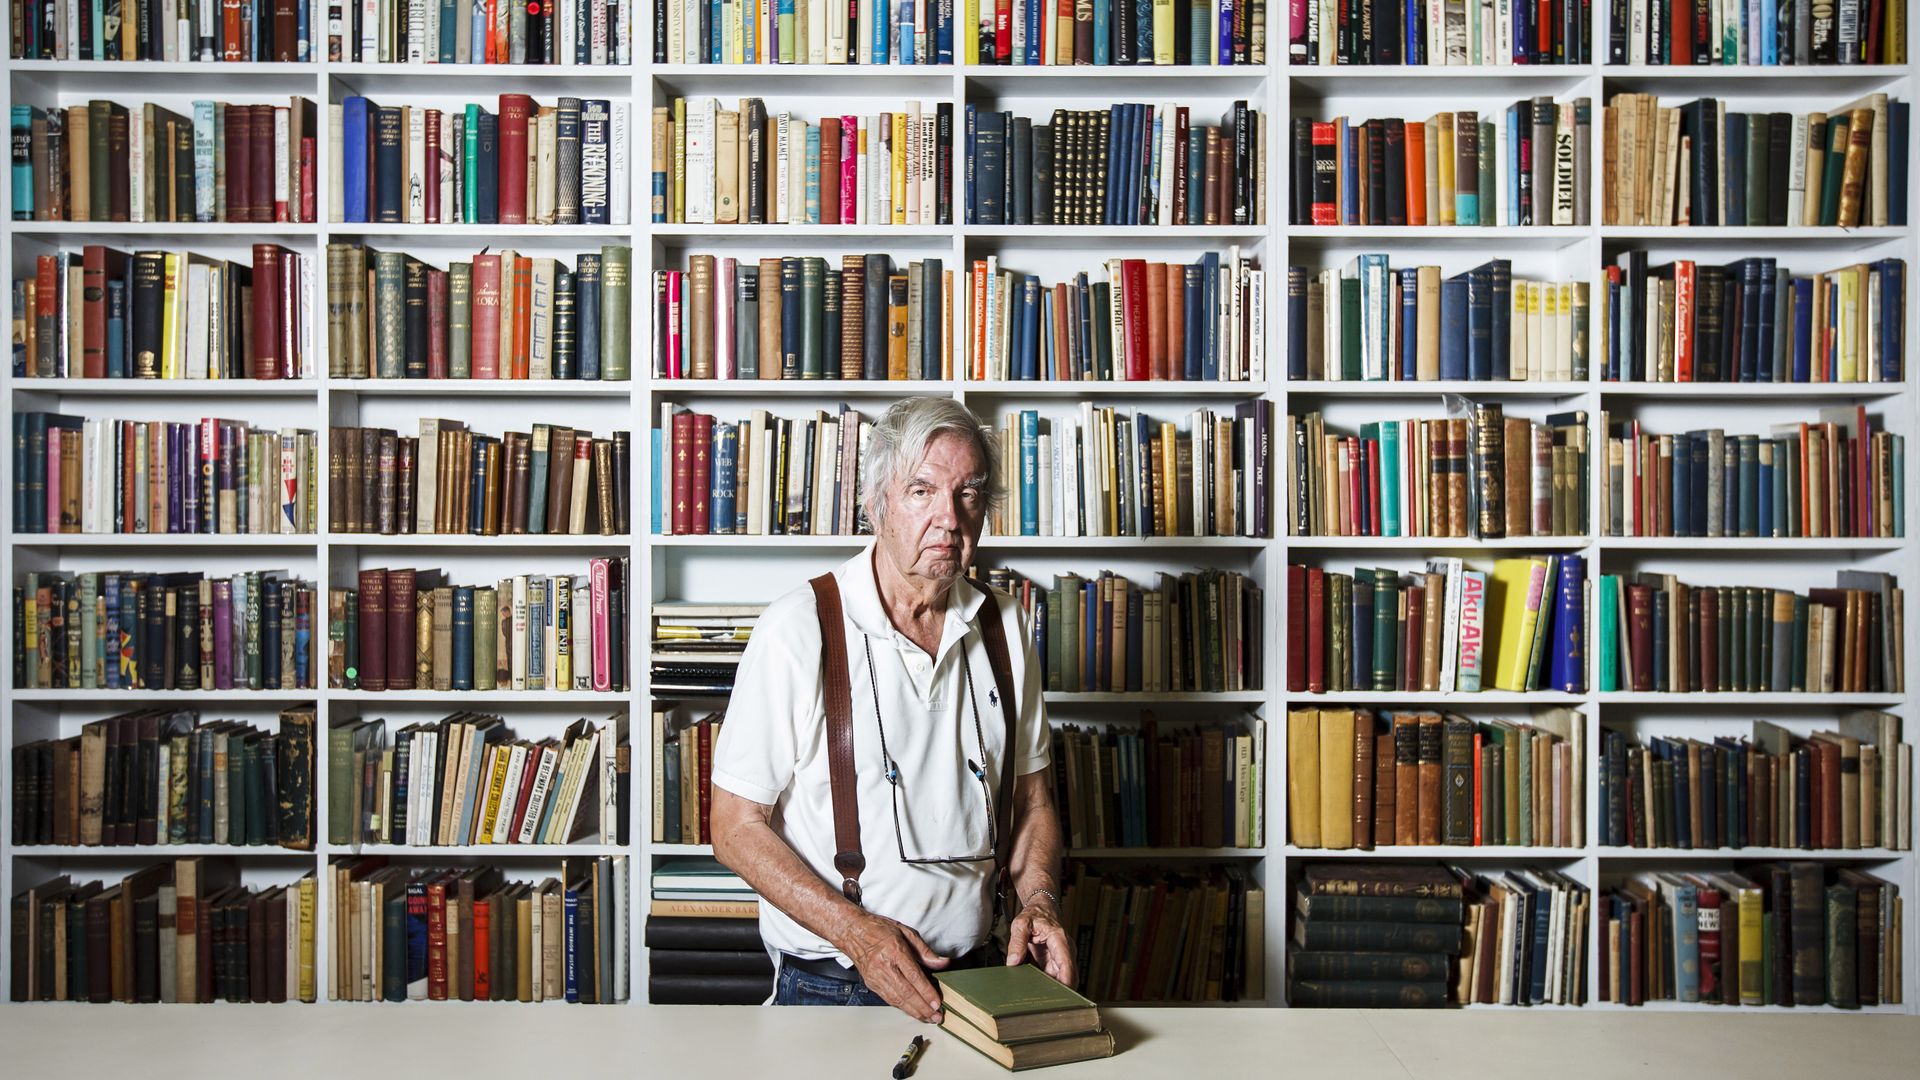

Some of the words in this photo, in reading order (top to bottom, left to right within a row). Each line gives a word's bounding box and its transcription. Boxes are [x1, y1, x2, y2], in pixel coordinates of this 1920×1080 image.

[1309, 0, 1319, 43] REFUGE
[587, 122, 601, 143] THE
[778, 113, 788, 134] DAVID
[675, 122, 684, 181] LEISERSON
[778, 135, 788, 161] MAMET
[615, 152, 625, 172] OUT
[1556, 134, 1573, 211] SOLDIER
[582, 143, 607, 208] RECKONING
[1177, 189, 1185, 203] Body
[1113, 286, 1122, 326] UNITROL
[715, 458, 732, 467] WEB
[712, 489, 734, 498] ROCK
[595, 568, 605, 593] Marcel
[559, 588, 568, 611] PAUSE
[595, 593, 604, 615] Proust
[559, 628, 568, 655] DESERT
[498, 750, 508, 763] JOHN
[544, 751, 554, 764] JOHN
[491, 763, 506, 794] BETJEMAN'S
[534, 764, 552, 794] BETJEMAN'S
[486, 795, 501, 820] COLLECTED
[528, 794, 543, 819] COLLECTED
[482, 820, 494, 835] POEMS
[523, 819, 536, 836] POEMS
[407, 887, 423, 895] SIGAL
[670, 905, 731, 913] ALEXANDER
